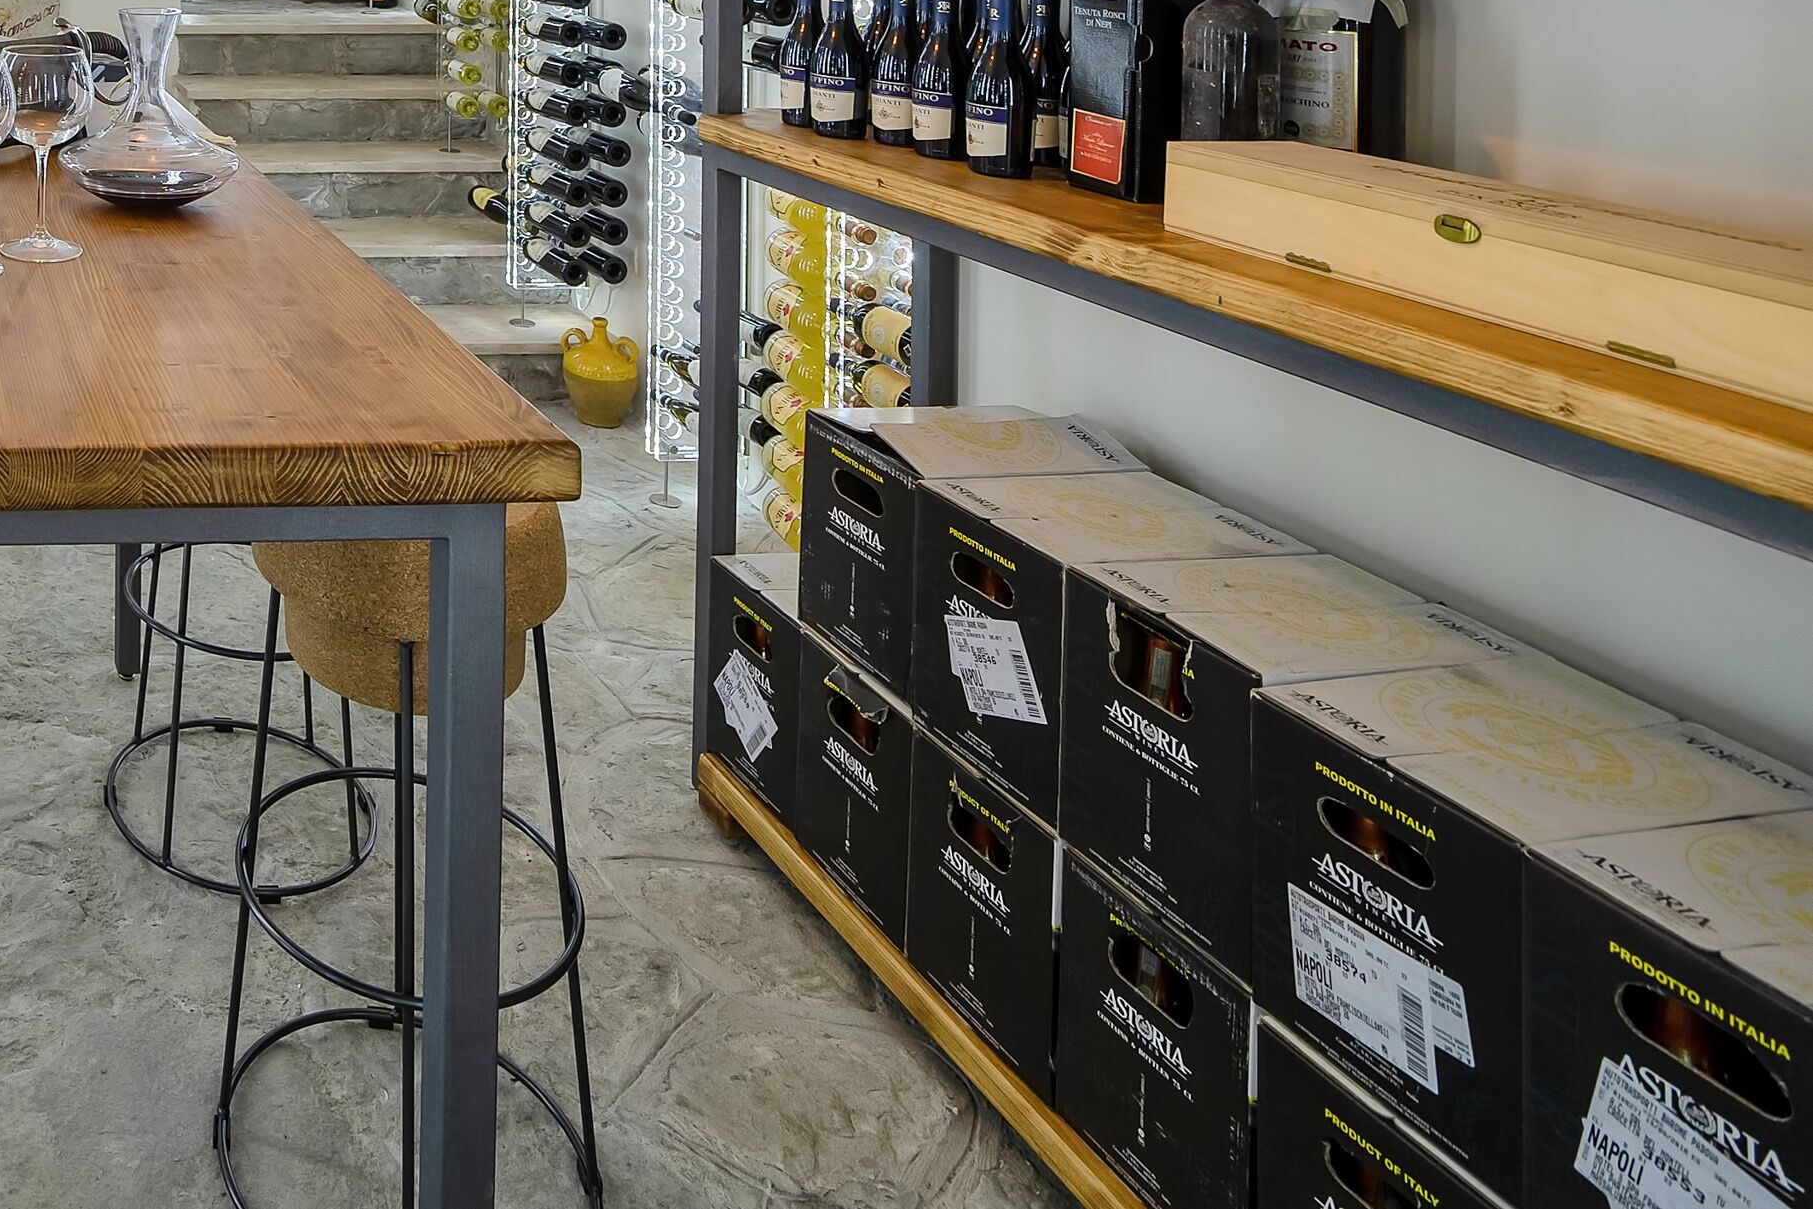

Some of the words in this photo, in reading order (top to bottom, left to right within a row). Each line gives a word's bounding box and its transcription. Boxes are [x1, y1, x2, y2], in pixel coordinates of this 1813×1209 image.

[1073, 5, 1101, 18] TENUTA
[1102, 9, 1126, 21] RONCI
[1095, 19, 1112, 29] NEPI
[828, 506, 886, 552] ASTORIA
[949, 526, 985, 553] PRODOTTO
[984, 547, 993, 560] IN
[993, 551, 1016, 572] ITALIA
[960, 666, 984, 688] NAPOLI
[1103, 699, 1199, 769] ASTORIA
[1291, 689, 1389, 746] ASTORIA
[823, 736, 879, 792] ASTORIA
[1102, 725, 1135, 752] CONTIENE
[1141, 751, 1179, 782] BOTTIGLIE
[1180, 776, 1189, 788] 75
[1189, 783, 1201, 796] CL
[990, 813, 1010, 834] ITALY
[1315, 761, 1377, 806] PRODOTTO
[1379, 800, 1393, 816] IN
[1396, 811, 1436, 842] ITALIA
[941, 845, 1011, 913] ASTORIA
[1311, 853, 1444, 947] ASTORIA
[1575, 849, 1718, 934] ASTORIA
[1309, 880, 1355, 918] CONTIENE
[1364, 917, 1418, 958] BOTTIGLIE
[1353, 895, 1398, 930] WINES
[1295, 947, 1333, 990] NAPOLI
[1099, 987, 1193, 1075] ASTORIA
[1609, 941, 1700, 1007] PRODOTTO
[1704, 999, 1724, 1021] IN
[1729, 1013, 1791, 1062] ITALIA
[1097, 1009, 1130, 1043] CONTAINS
[1137, 1047, 1170, 1081] BOTTLES
[1586, 1123, 1645, 1186] NAPOLI
[1618, 1054, 1806, 1194] ASTORIA
[1660, 1107, 1689, 1142] BARONE
[1324, 1107, 1382, 1161] PRODUCT
[1384, 1158, 1401, 1175] OF
[1404, 1173, 1440, 1208] ITALY
[1640, 1143, 1707, 1206] 38553
